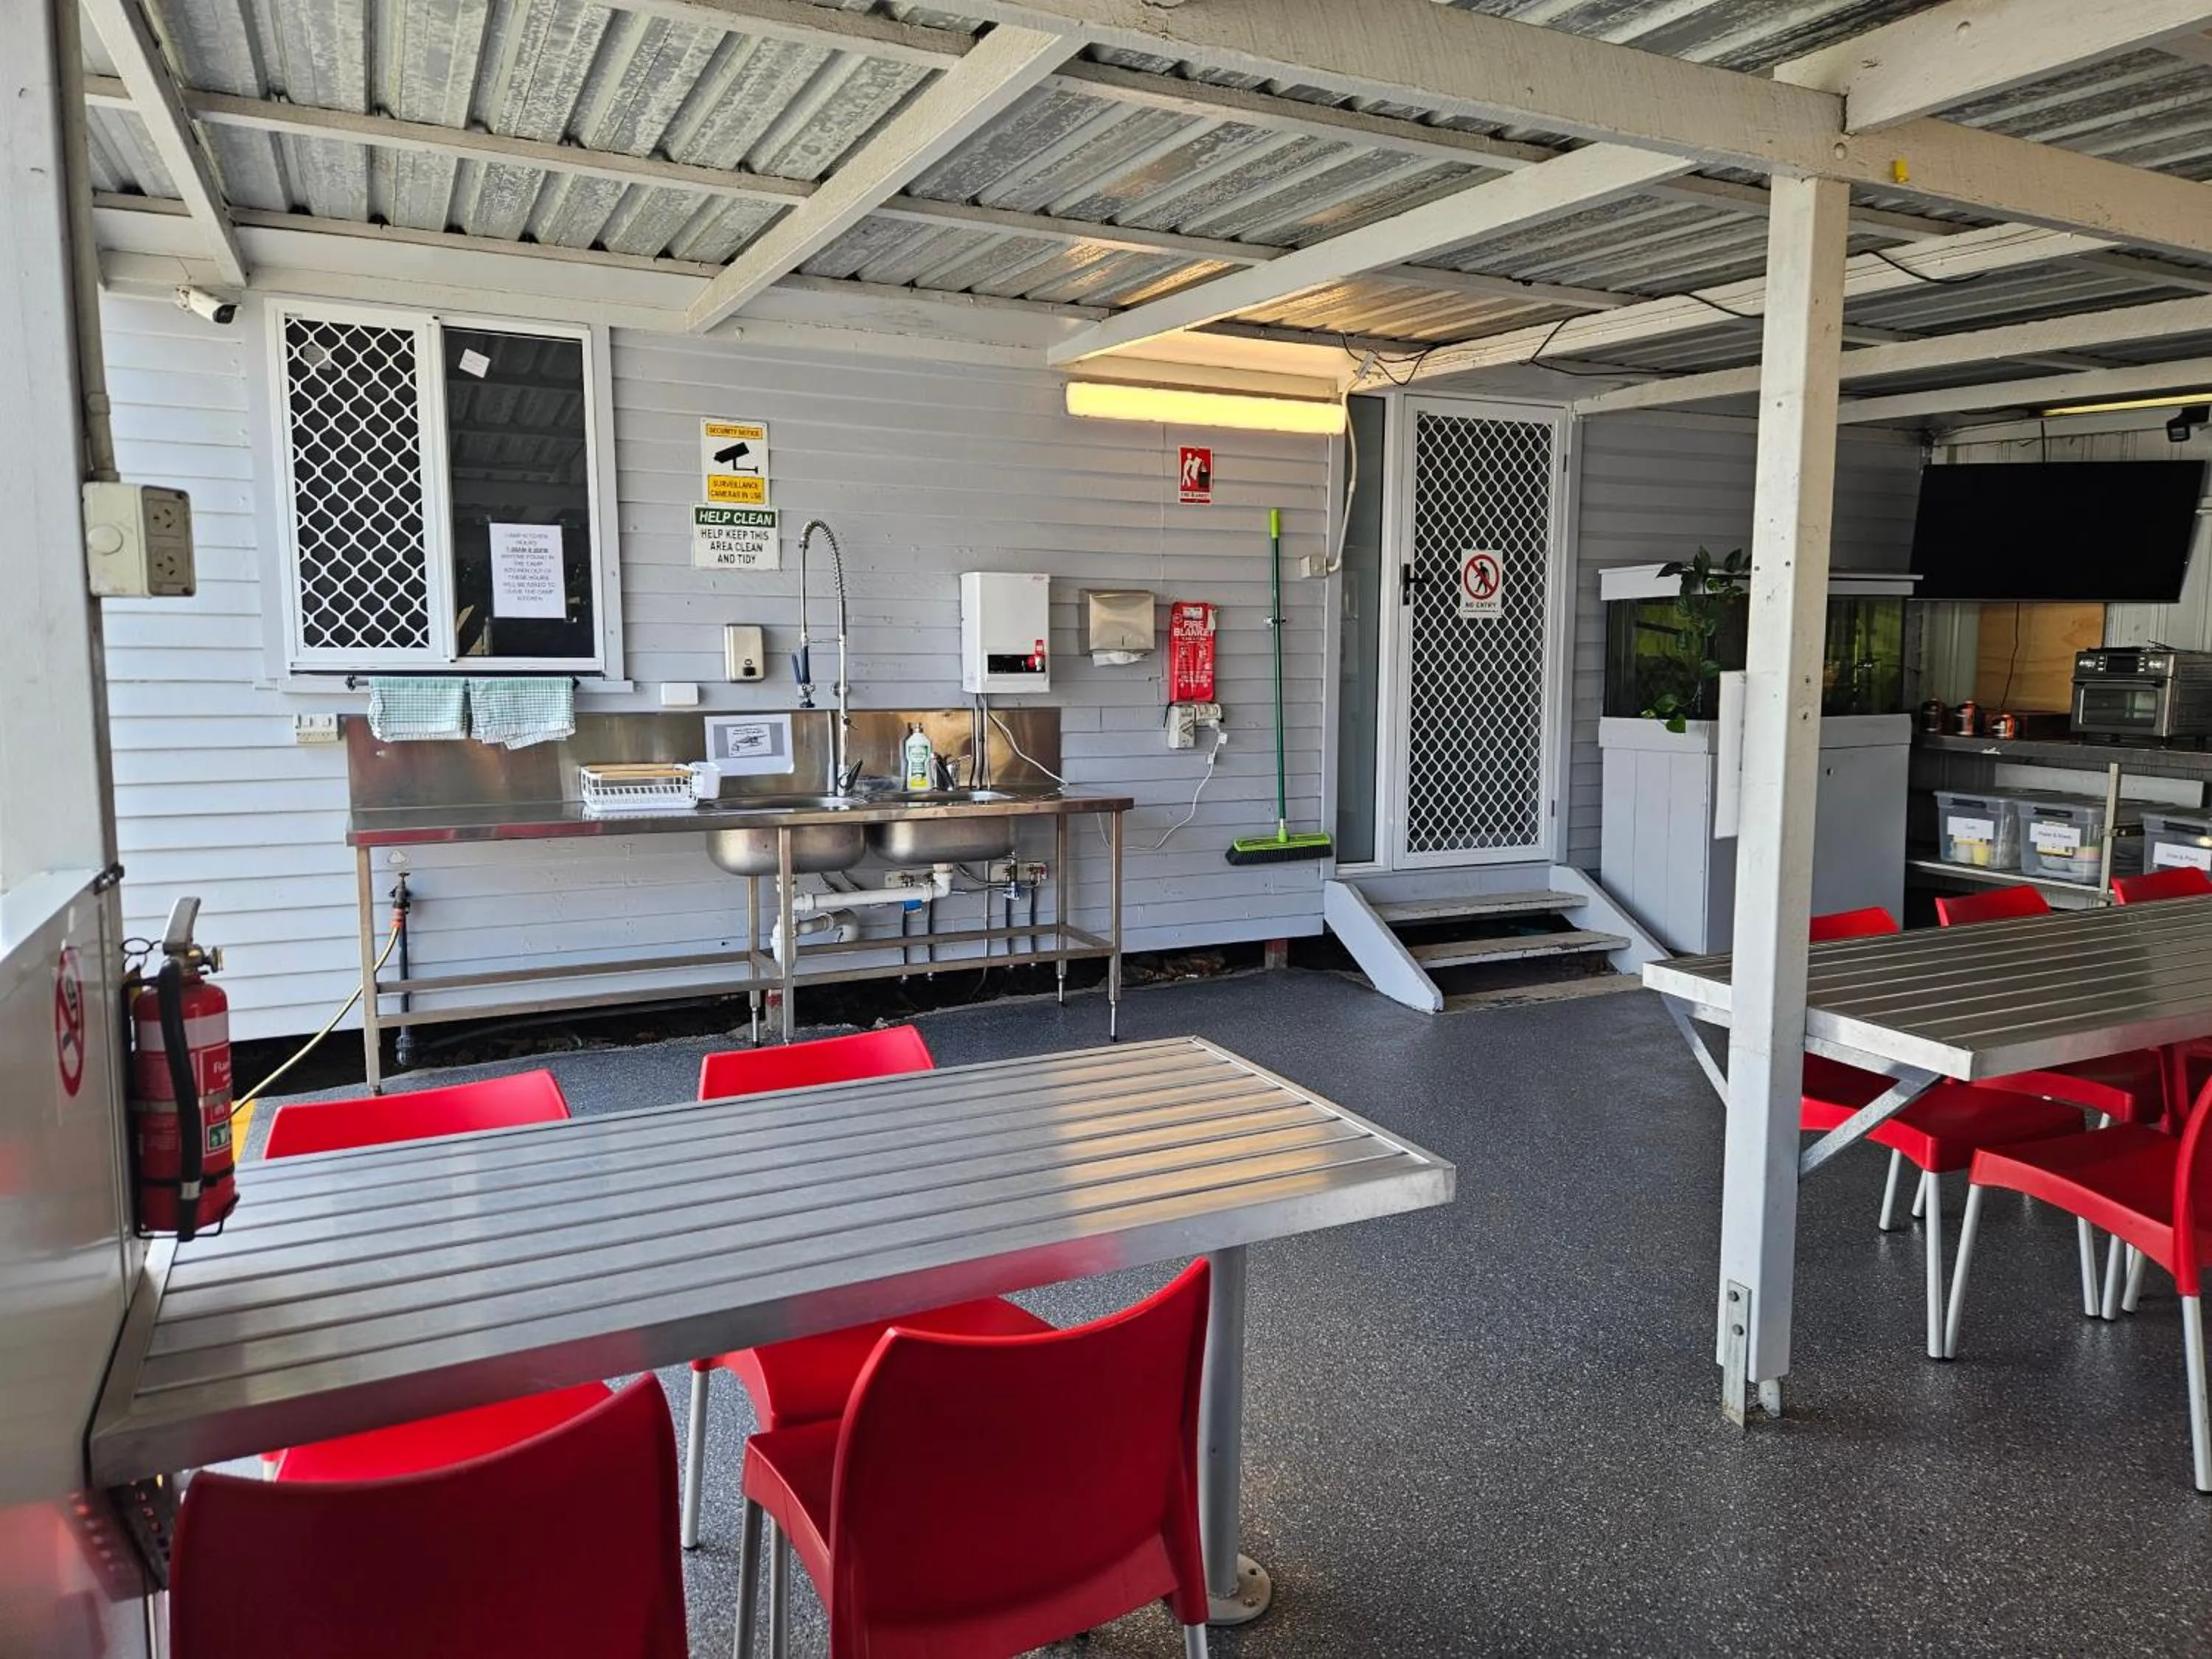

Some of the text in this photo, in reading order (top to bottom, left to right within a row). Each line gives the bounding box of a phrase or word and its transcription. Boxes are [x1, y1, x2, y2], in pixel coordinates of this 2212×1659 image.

[700, 510, 772, 525] HELP CLEAN
[701, 529, 769, 540] HELP KEEP THIS
[710, 541, 762, 552] AREA CLEAN
[717, 554, 756, 564] AND TIDY
[1183, 620, 1204, 628] FIRE
[1173, 627, 1213, 637] BLANKET
